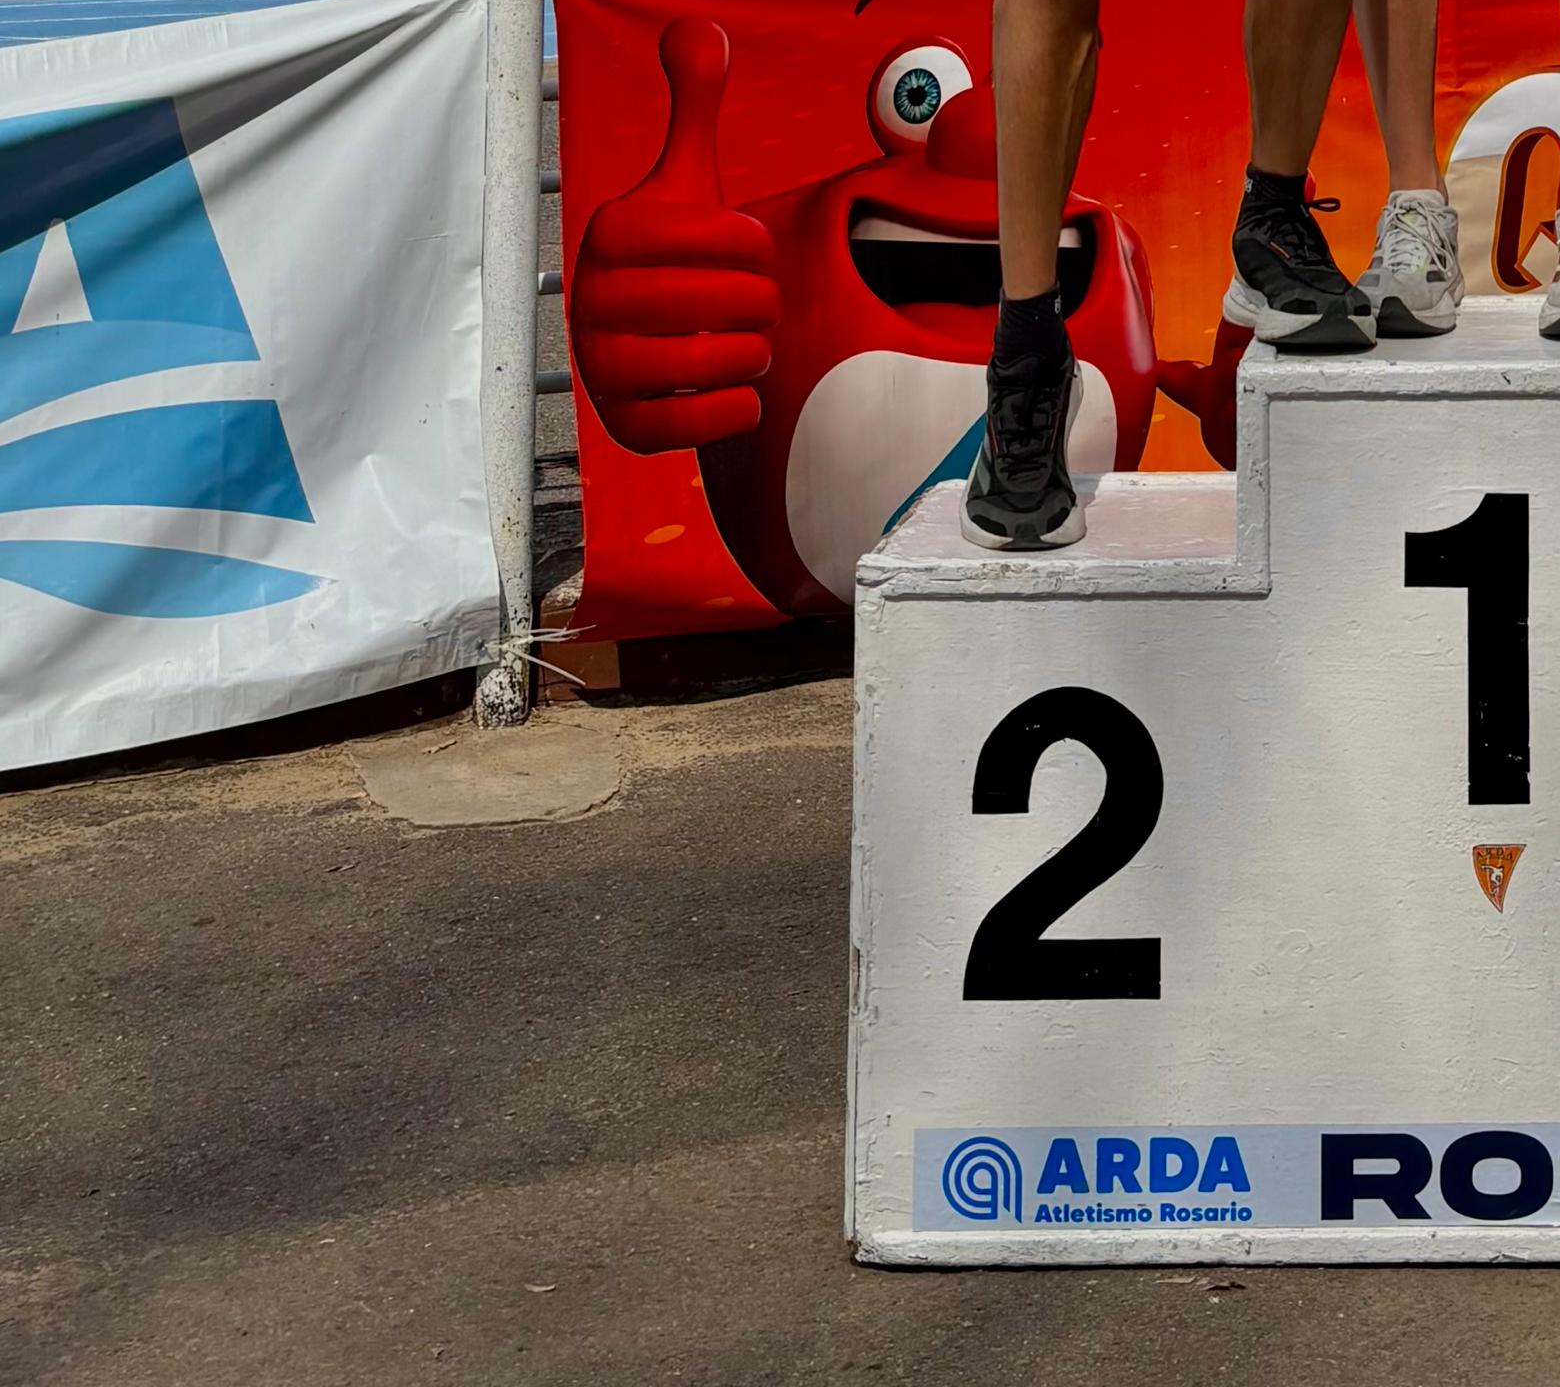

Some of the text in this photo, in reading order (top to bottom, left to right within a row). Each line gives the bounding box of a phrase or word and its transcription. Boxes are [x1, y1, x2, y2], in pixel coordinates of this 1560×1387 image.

[1405, 493, 1530, 805] 1
[963, 687, 1163, 1000] 2
[1034, 1201, 1253, 1224] Atletismo Rosario
[1036, 1136, 1252, 1194] ARDA
